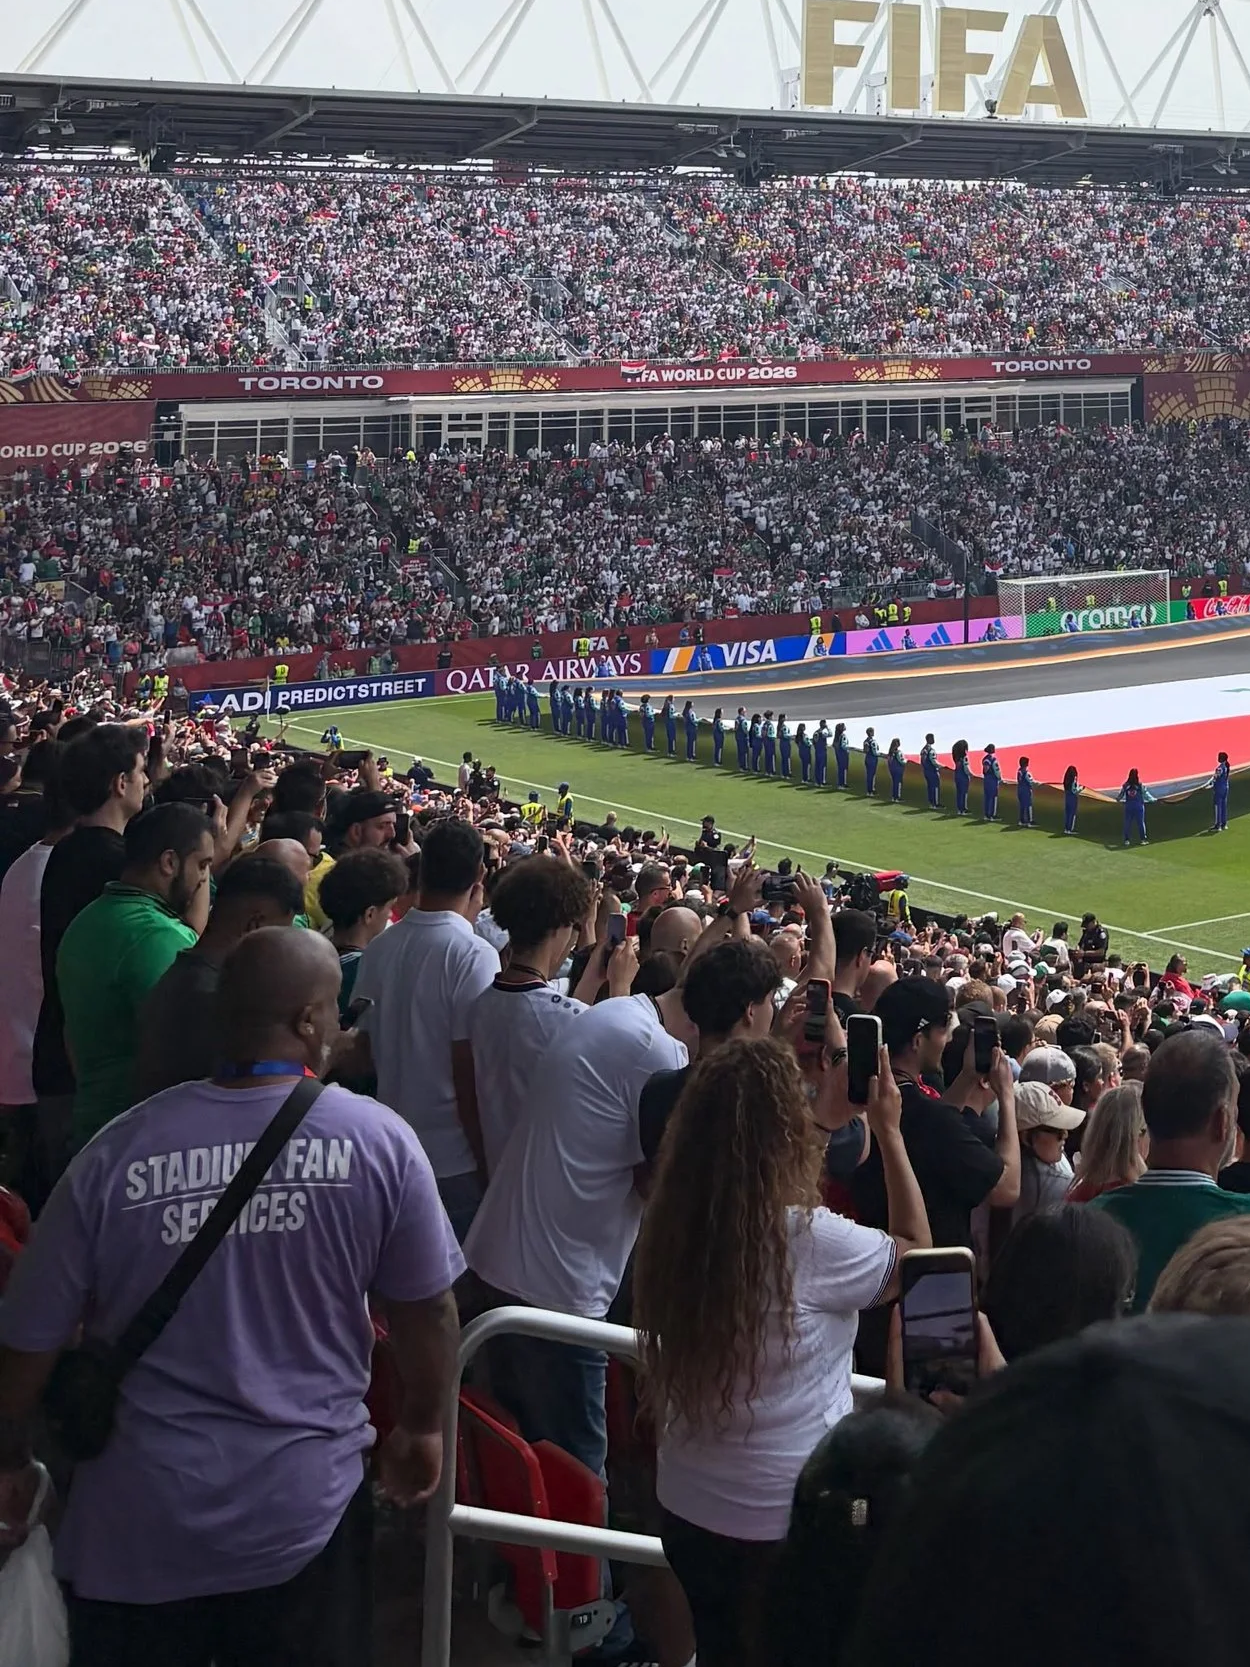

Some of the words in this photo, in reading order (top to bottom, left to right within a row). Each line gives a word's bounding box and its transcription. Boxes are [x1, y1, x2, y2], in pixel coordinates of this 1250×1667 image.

[661, 368, 714, 382] WORLD
[717, 367, 746, 380] CUP
[747, 366, 797, 379] 2026
[992, 359, 1091, 373] TORONTO
[238, 375, 384, 391] TORONTO
[51, 443, 86, 456] CUP
[572, 636, 610, 653] FFA
[717, 639, 777, 667] VISA
[277, 678, 427, 706] PREDICTSTREET
[126, 1142, 273, 1201] STADIU
[285, 1138, 353, 1180] FAN
[161, 1191, 307, 1246] SERICES
